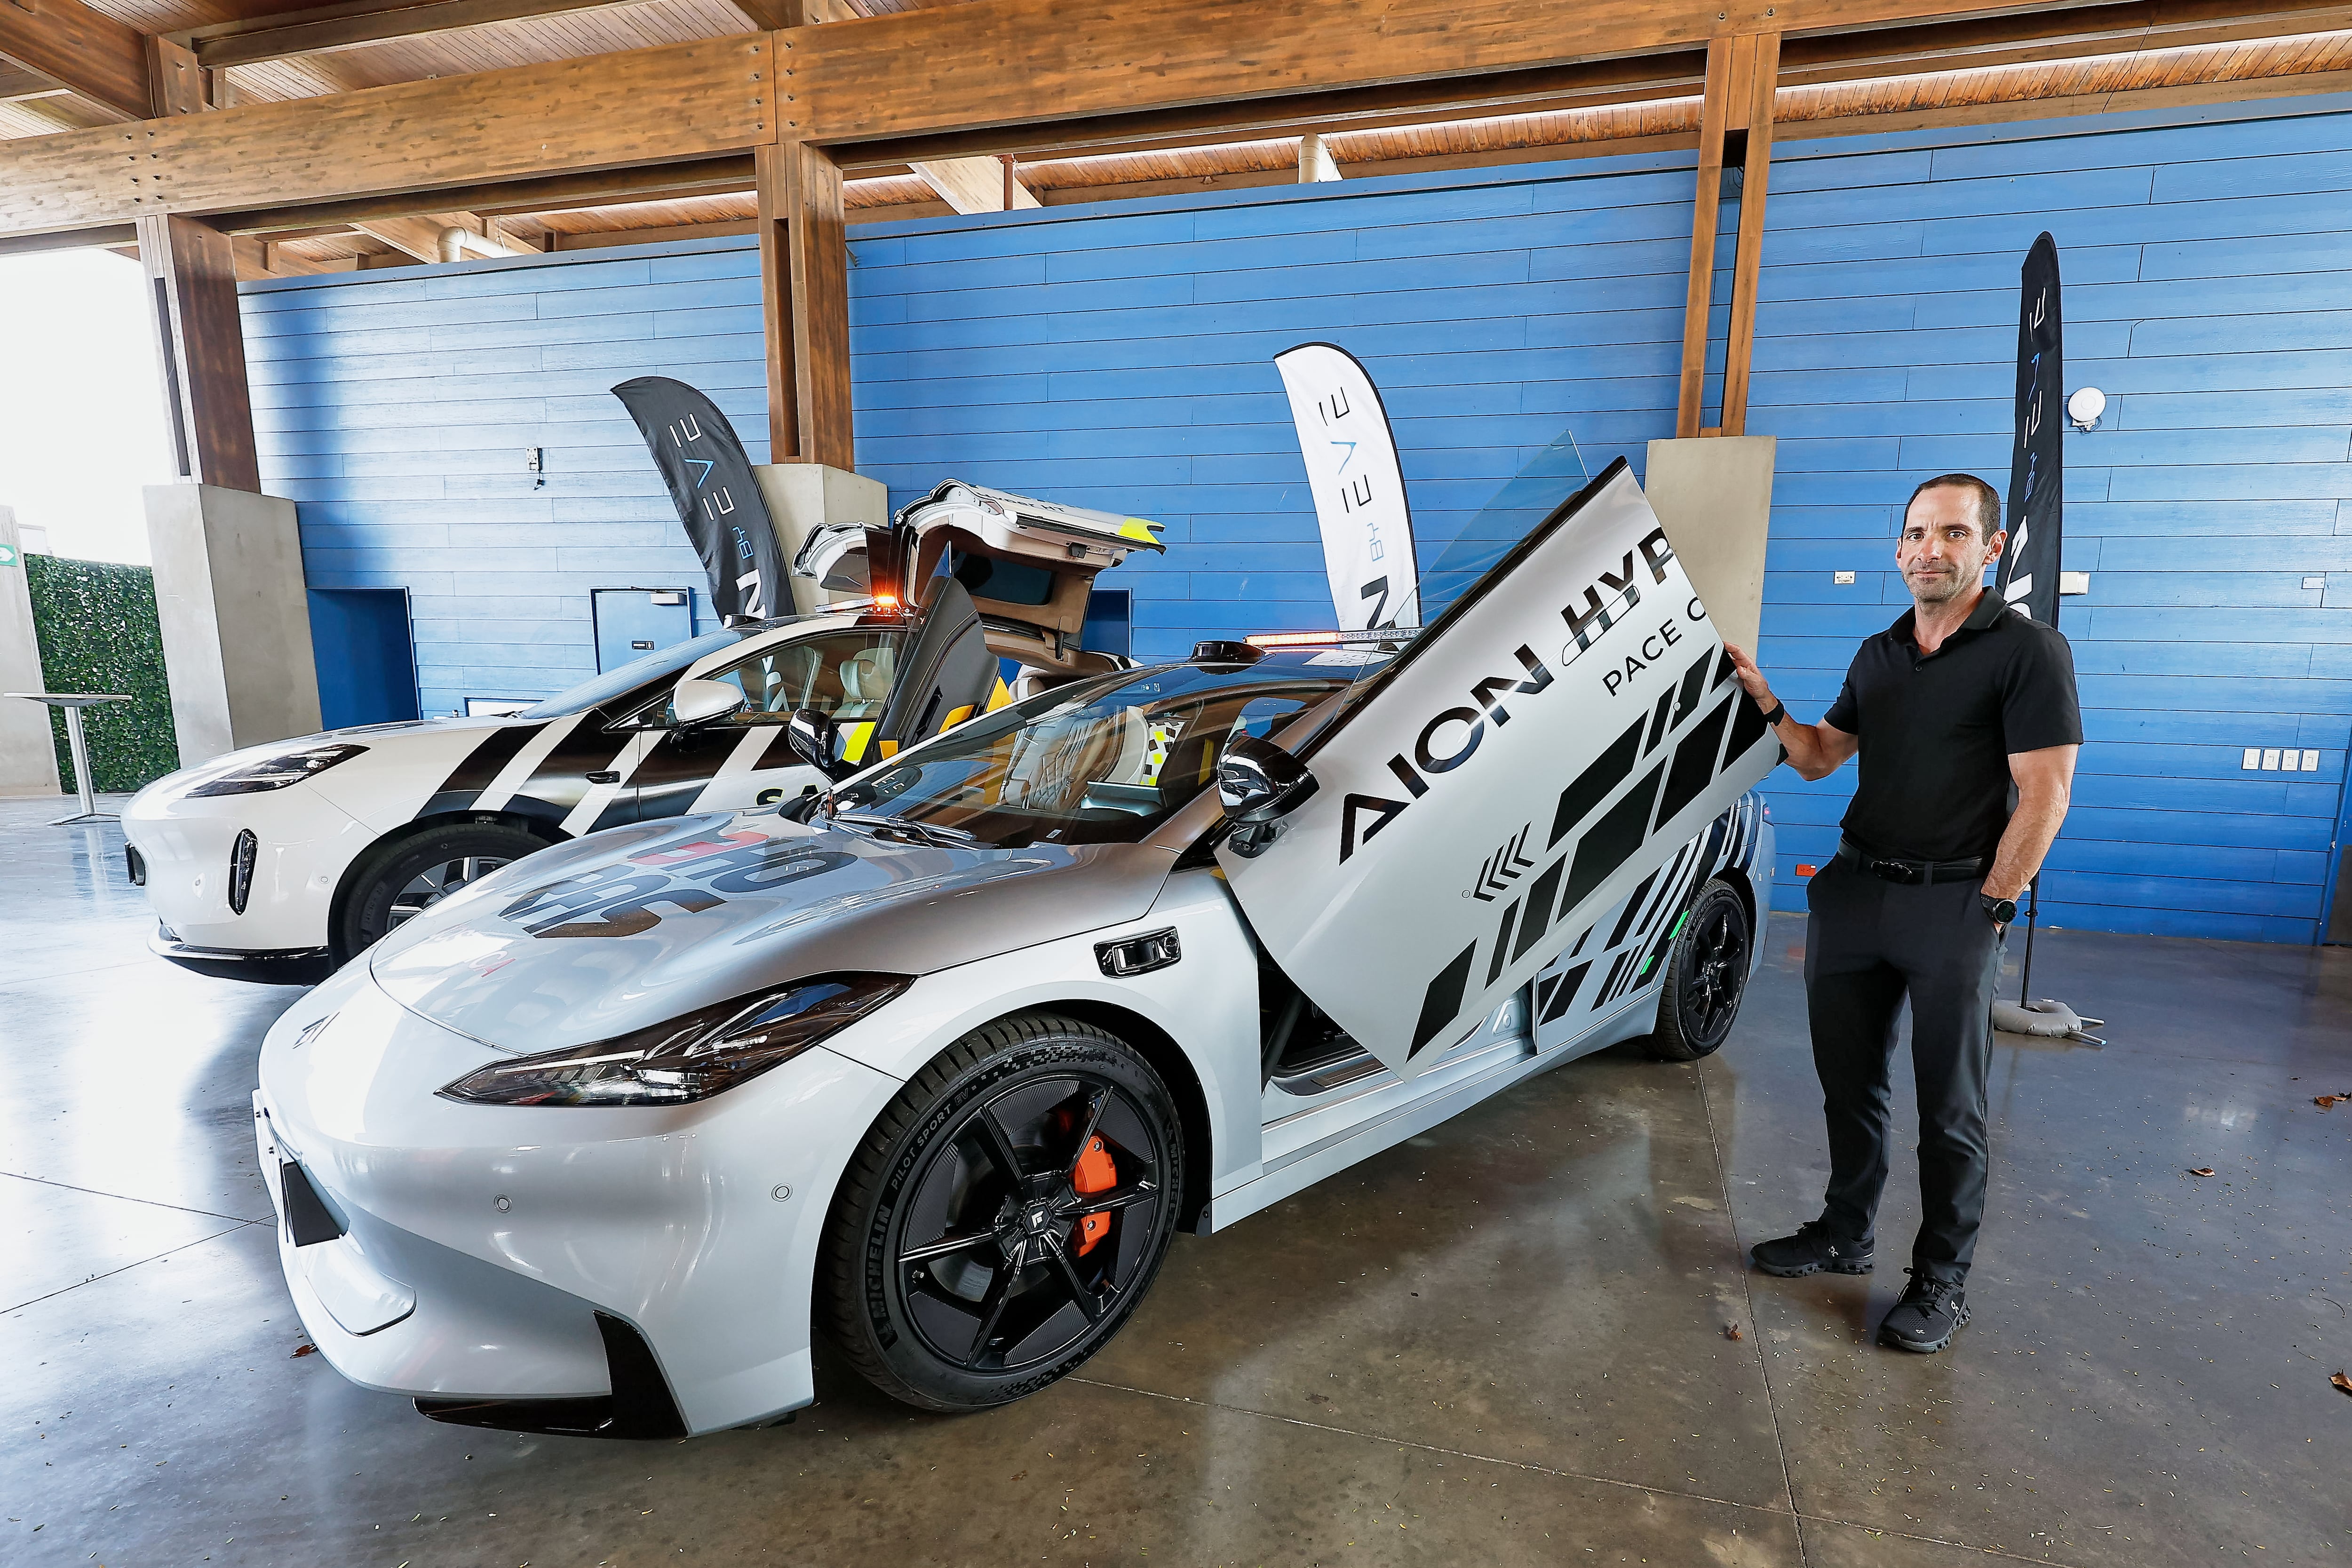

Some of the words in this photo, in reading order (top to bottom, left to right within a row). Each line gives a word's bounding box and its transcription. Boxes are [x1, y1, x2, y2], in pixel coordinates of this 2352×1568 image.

[732, 526, 754, 560] BY
[1367, 523, 1384, 562] BY
[1602, 624, 1682, 697] PACE
[1339, 643, 1555, 866] AION
[868, 1204, 891, 1318] MICHELIN
[891, 1147, 915, 1190] PILOT
[918, 1104, 951, 1147] SPORT
[954, 1088, 969, 1106] EV
